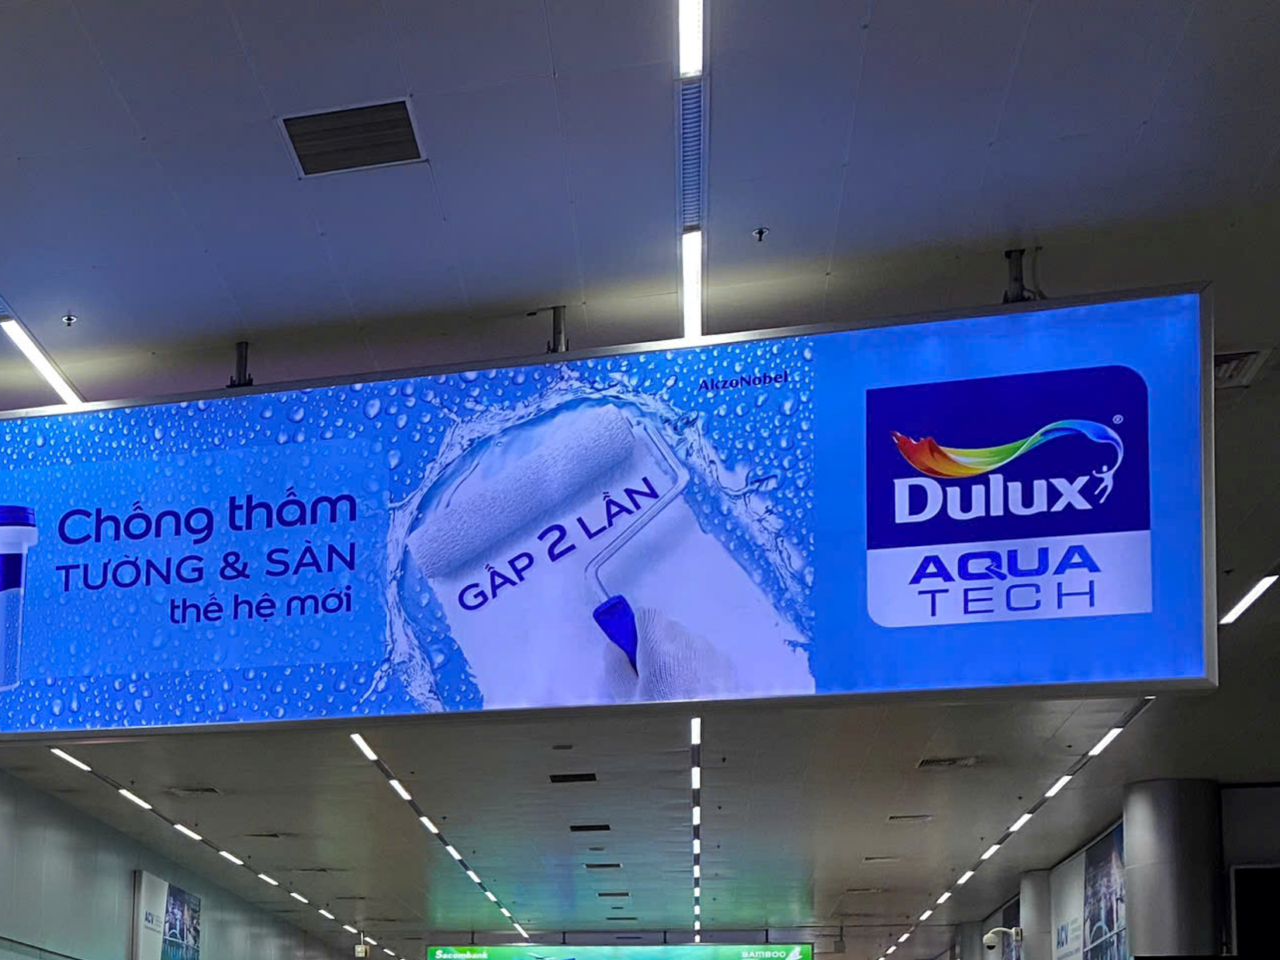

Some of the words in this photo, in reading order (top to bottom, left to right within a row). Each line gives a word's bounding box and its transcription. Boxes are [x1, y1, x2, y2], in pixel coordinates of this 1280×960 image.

[698, 370, 789, 393] AkzoNobel
[58, 500, 214, 545] Chống
[228, 486, 357, 531] thấm
[893, 474, 1093, 524] Dulux
[458, 551, 535, 611] GẤP
[537, 524, 577, 562] 2
[576, 476, 660, 540] LẦN
[56, 554, 204, 592] TƯỜNG
[220, 551, 250, 580] &
[265, 540, 356, 577] SÀN
[908, 545, 1102, 585] AQUA
[170, 593, 224, 624] thế
[233, 592, 276, 622] hệ
[286, 584, 352, 616] mới
[918, 580, 1095, 617] TECH
[435, 949, 488, 960] Sacombank
